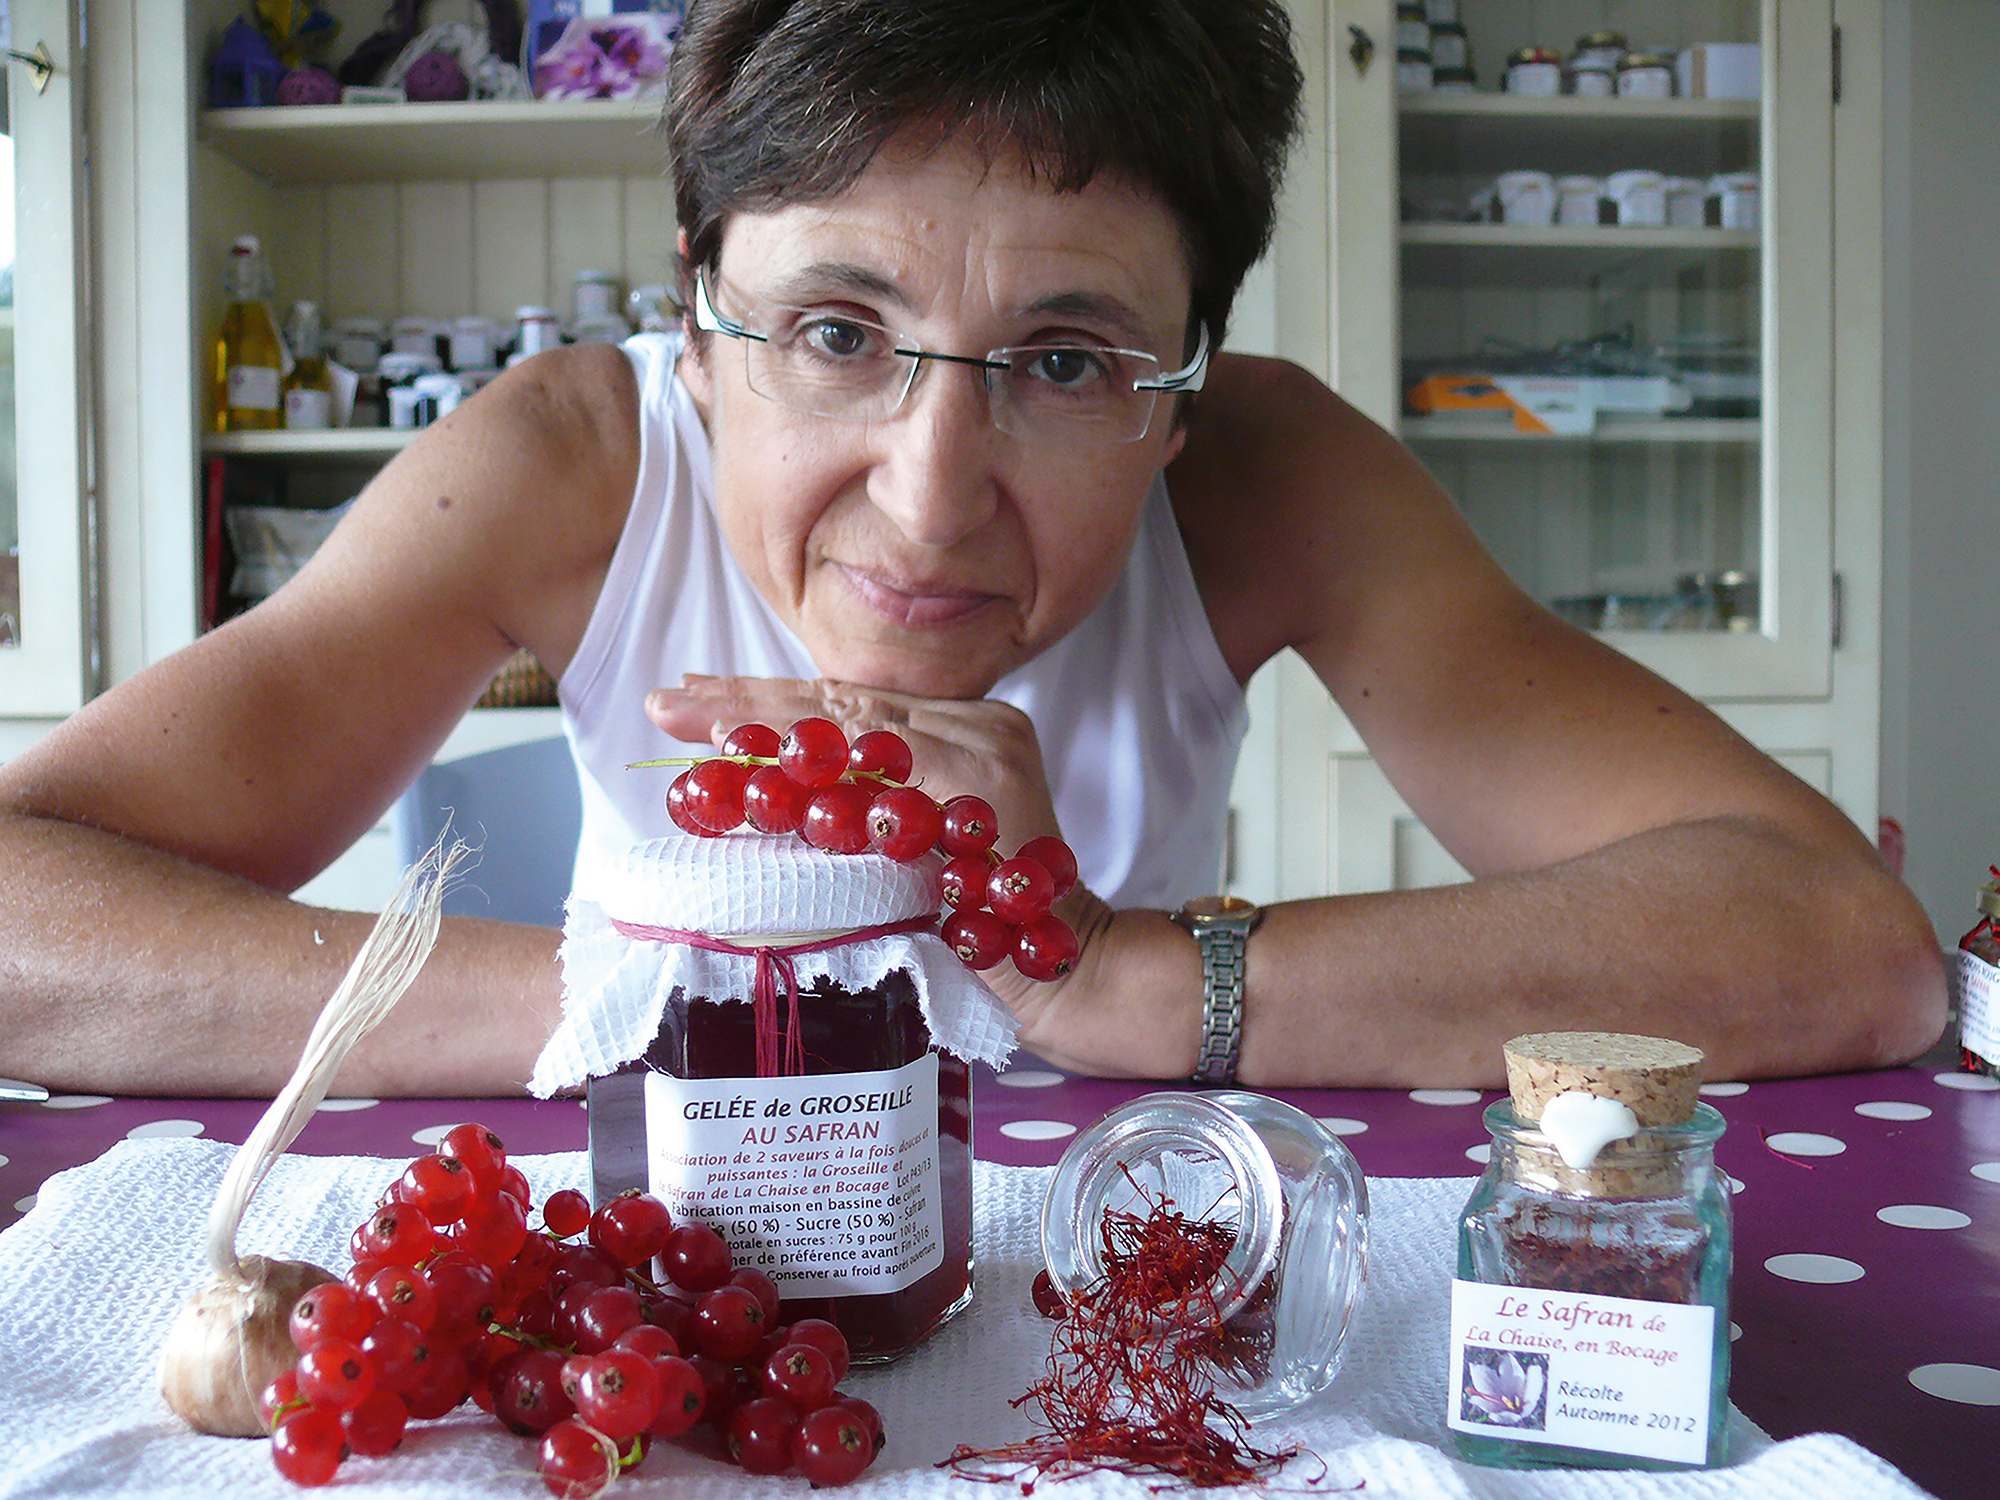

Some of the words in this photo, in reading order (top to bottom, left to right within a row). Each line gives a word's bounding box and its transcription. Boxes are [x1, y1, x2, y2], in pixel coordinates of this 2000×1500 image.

[683, 1095, 757, 1120] GELÉE
[764, 1098, 791, 1117] de
[800, 1084, 913, 1116] GROSEILLE
[741, 1126, 777, 1145] AU
[784, 1121, 880, 1144] SAFRAN
[732, 1151, 751, 1164] de
[756, 1151, 766, 1163] 2
[771, 1150, 830, 1163] saveurs
[835, 1146, 844, 1159] à
[849, 1146, 863, 1159] la
[868, 1144, 895, 1160] fois
[706, 1169, 788, 1185] puissantes
[803, 1165, 817, 1178] la
[822, 1161, 888, 1177] Groseille
[892, 1160, 903, 1172] et
[667, 1182, 705, 1201] Safran
[711, 1187, 729, 1199] de
[734, 1186, 752, 1198] La
[757, 1183, 808, 1197] Chaise
[813, 1184, 830, 1194] en
[836, 1181, 890, 1194] Bocage
[671, 1201, 744, 1217] Fabrication
[749, 1201, 801, 1214] maison
[806, 1201, 822, 1212] en
[828, 1197, 882, 1210] bassine
[887, 1194, 901, 1207] de
[731, 1220, 757, 1236] (50
[762, 1218, 780, 1234] %)
[796, 1217, 841, 1231] Sucre
[847, 1214, 873, 1230] (50
[878, 1211, 895, 1228] %)
[728, 1238, 762, 1250] totale
[766, 1239, 781, 1248] en
[786, 1237, 826, 1247] sucres
[838, 1233, 853, 1244] 75
[857, 1235, 865, 1246] g
[869, 1232, 897, 1245] pour
[757, 1252, 775, 1264] de
[780, 1249, 857, 1266] préférence
[861, 1246, 898, 1260] avant
[767, 1270, 830, 1281] Conserver
[832, 1269, 847, 1278] au
[852, 1264, 881, 1277] froid
[885, 1259, 909, 1275] après
[1496, 1296, 1528, 1318] Le
[1537, 1300, 1635, 1331] Safran
[1642, 1314, 1667, 1333] de
[1465, 1326, 1490, 1341] La
[1499, 1329, 1568, 1352] Chaise,
[1574, 1340, 1600, 1353] en
[1605, 1341, 1679, 1367] Bocage
[1557, 1380, 1624, 1402] Récolte
[1556, 1403, 1640, 1427] Automne
[1646, 1413, 1696, 1433] 2012
